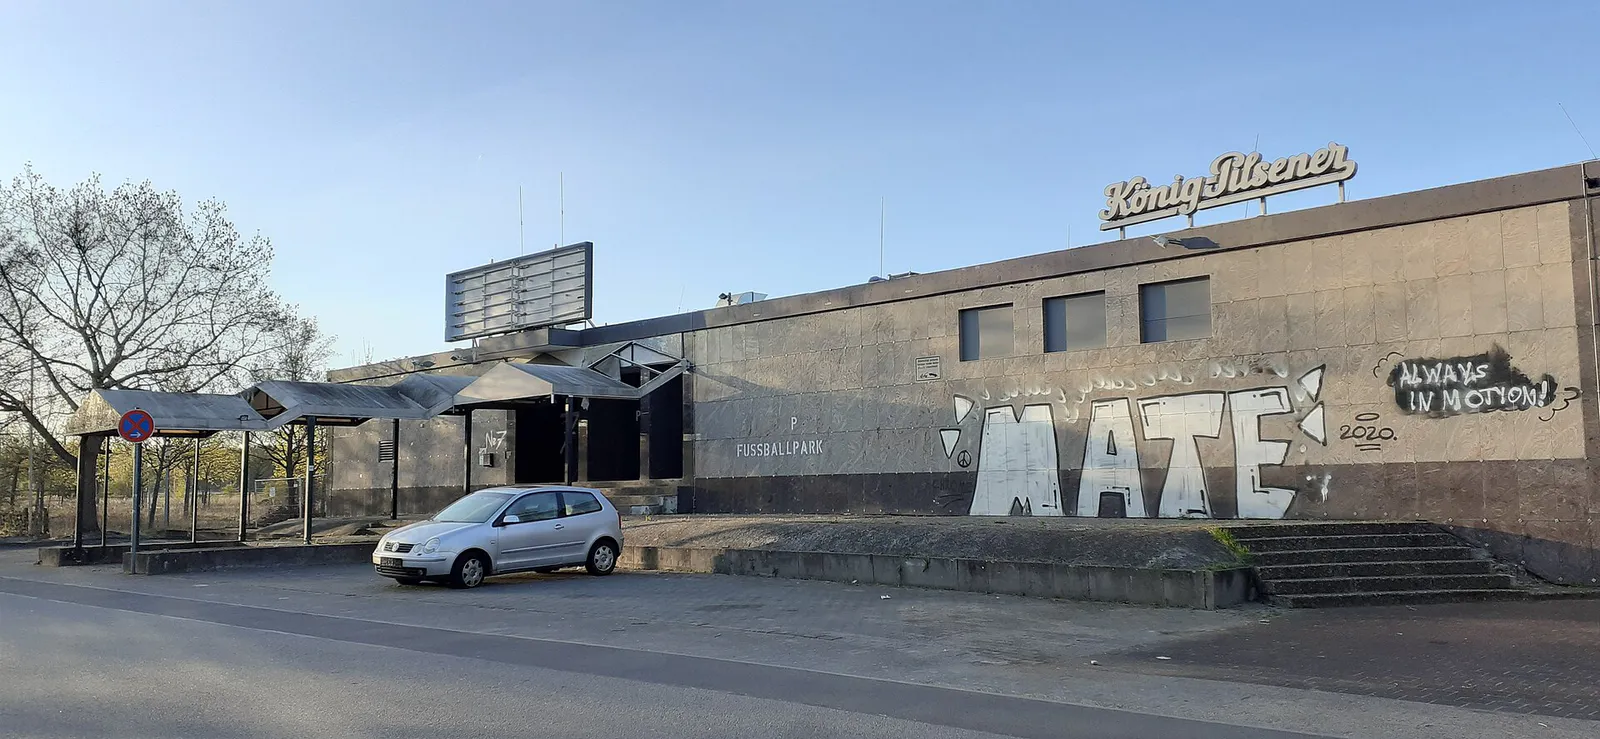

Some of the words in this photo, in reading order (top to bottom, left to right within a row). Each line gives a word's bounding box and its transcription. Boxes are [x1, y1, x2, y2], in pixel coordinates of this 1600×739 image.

[1400, 361, 1489, 387] ALWAYS
[1410, 390, 1434, 411] IN
[1442, 380, 1547, 411] MOTION!
[790, 416, 798, 430] P
[736, 440, 823, 457] FUSSBALLPARK
[969, 386, 1295, 519] MATE
